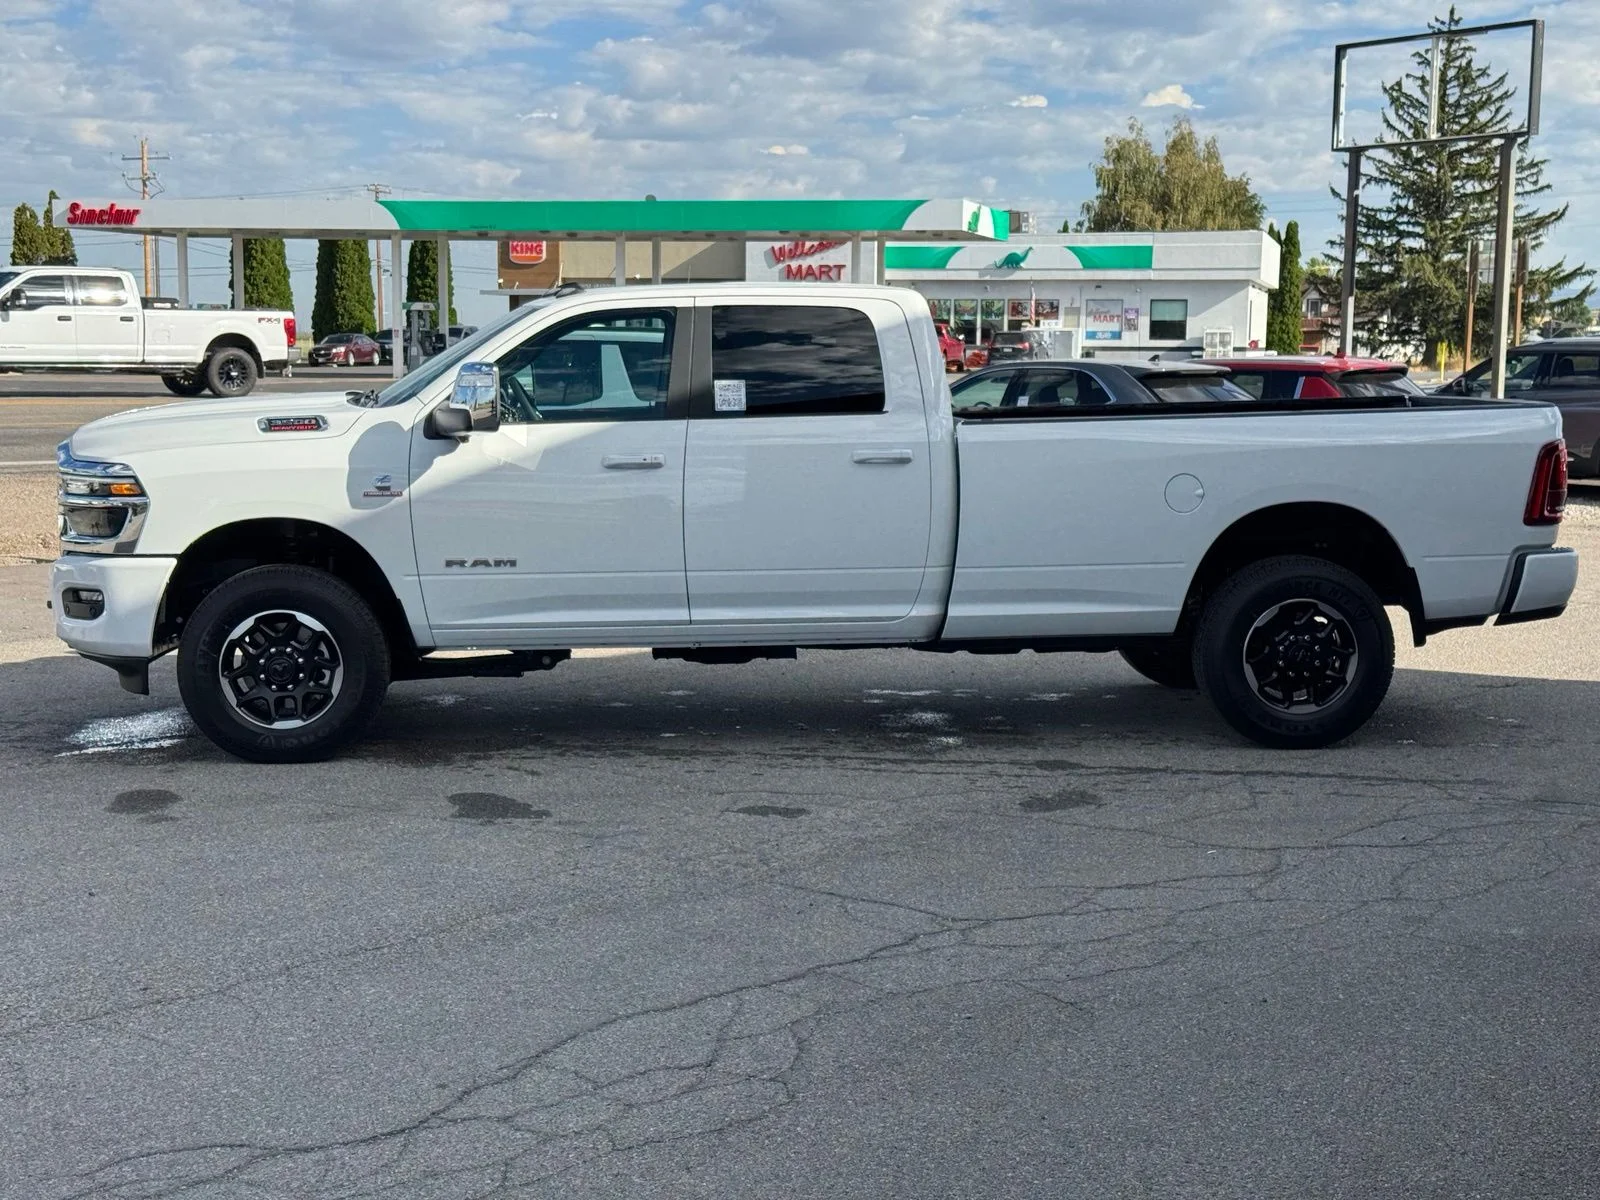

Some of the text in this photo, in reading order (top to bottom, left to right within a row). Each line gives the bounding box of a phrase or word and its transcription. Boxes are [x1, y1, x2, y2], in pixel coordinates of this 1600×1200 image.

[67, 202, 141, 225] Sinclair
[510, 243, 543, 255] KING
[785, 264, 846, 281] MART
[1093, 314, 1121, 323] MART
[445, 559, 517, 568] RAM
